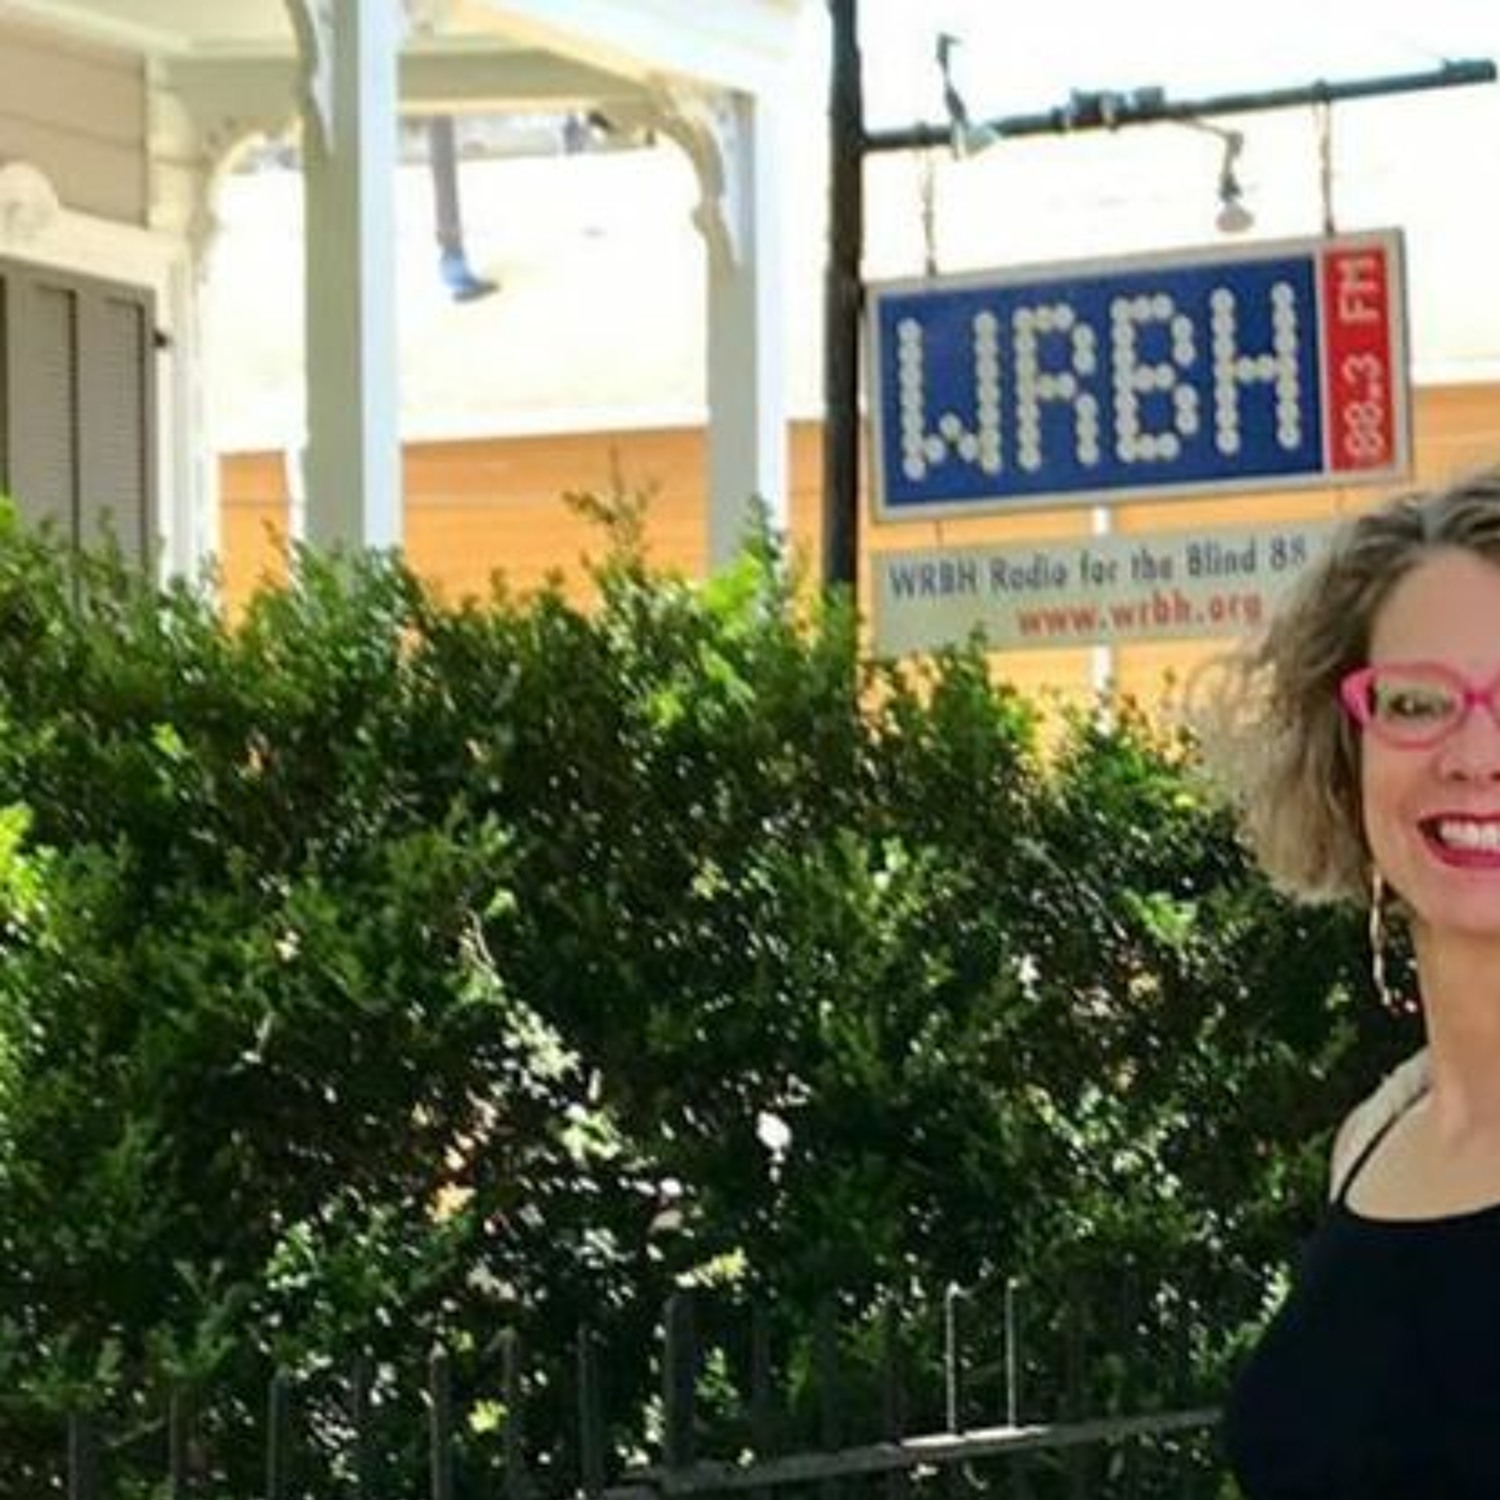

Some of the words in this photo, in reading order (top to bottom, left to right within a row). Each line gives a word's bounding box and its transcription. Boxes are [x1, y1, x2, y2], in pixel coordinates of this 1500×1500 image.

[1338, 258, 1381, 323] FM
[898, 282, 1299, 480] WRBH
[1343, 353, 1385, 460] 88.3
[889, 560, 978, 598] WRBH
[989, 553, 1068, 593] Radio
[1081, 550, 1119, 585] for
[1132, 546, 1174, 581] the
[1187, 536, 1257, 578] Blind
[1018, 588, 1264, 637] www.wrbh.org
